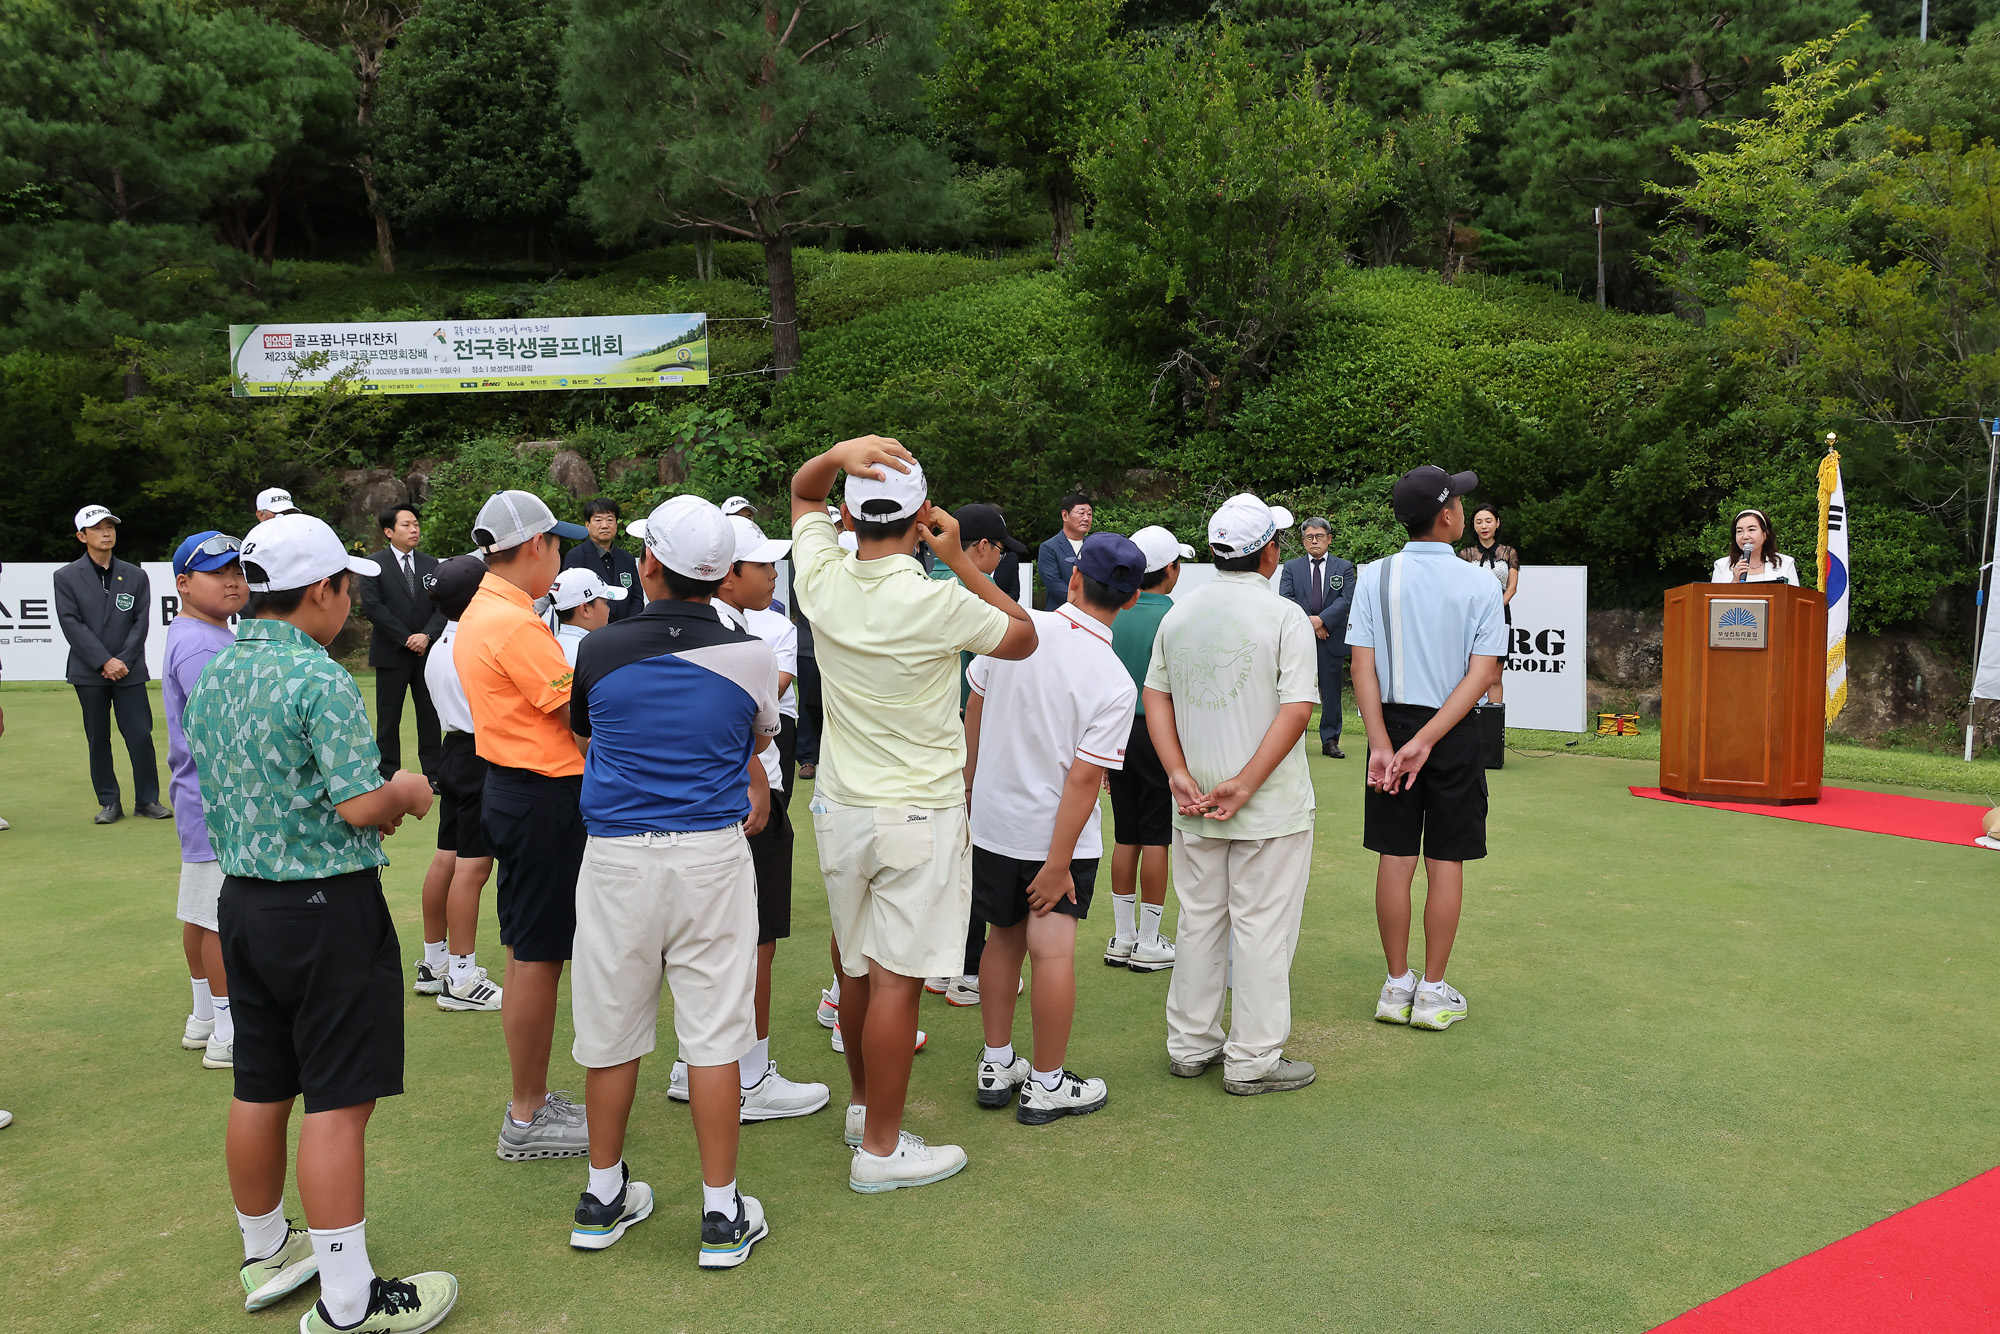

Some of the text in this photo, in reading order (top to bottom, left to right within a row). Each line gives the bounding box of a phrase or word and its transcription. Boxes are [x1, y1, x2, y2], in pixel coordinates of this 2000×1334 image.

[264, 333, 398, 348] 일요신문 골프꿈나무대잔치
[453, 334, 623, 361] 전국학생골프대회
[265, 348, 428, 362] 제23회 한등학교골프연맹회장배
[376, 368, 397, 376] 2026년
[471, 366, 484, 374] 장소
[490, 364, 534, 373] 보성컨트리클럽
[1242, 520, 1276, 554] ECO DECK
[1206, 697, 1227, 710] THE
[1228, 654, 1253, 699] WORLD
[330, 1243, 343, 1252] FJ
